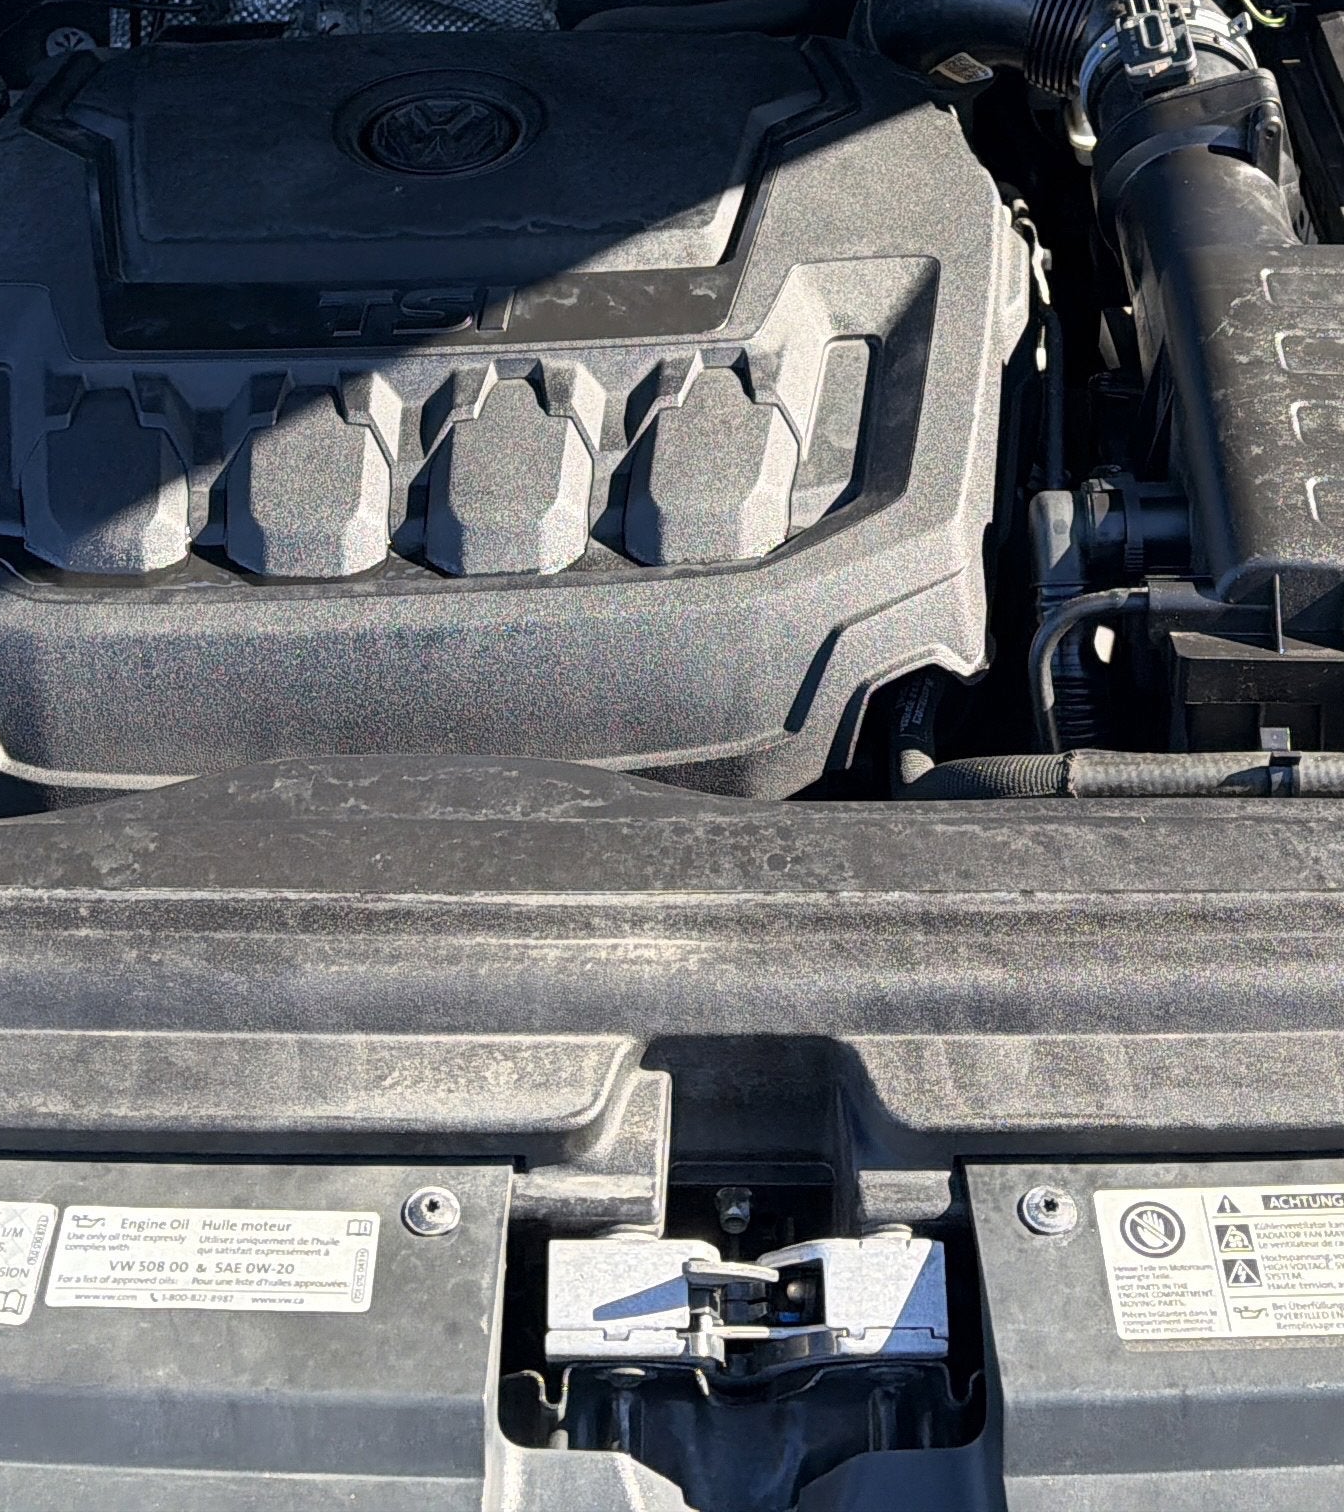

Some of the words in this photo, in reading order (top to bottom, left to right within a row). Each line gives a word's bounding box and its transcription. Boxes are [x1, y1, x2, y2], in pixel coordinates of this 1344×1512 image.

[318, 285, 516, 337] TSI
[1266, 1193, 1344, 1209] ACHTUNG
[118, 1217, 168, 1233] Engine
[168, 1218, 190, 1230] Oil
[200, 1218, 238, 1231] Huile
[240, 1220, 292, 1232] moteur
[1, 1226, 25, 1238] I/M
[65, 1231, 85, 1240] Use
[85, 1231, 107, 1243] only
[107, 1232, 121, 1241] oil
[120, 1232, 142, 1241] that
[141, 1233, 187, 1245] expressly
[1255, 1231, 1302, 1239] RADIATOR
[1302, 1230, 1323, 1238] FAN
[198, 1235, 234, 1244] Utilisez
[235, 1235, 295, 1247] uniquement
[296, 1237, 309, 1246] de
[1257, 1241, 1270, 1249] Le
[1319, 1239, 1333, 1248] de
[63, 1242, 107, 1253] complies
[107, 1243, 130, 1251] with
[196, 1246, 213, 1256] qui
[107, 1259, 135, 1272] VW
[137, 1260, 166, 1272] 508
[167, 1260, 190, 1273] 00
[195, 1263, 208, 1273] &
[213, 1261, 242, 1274] SAE
[244, 1262, 295, 1275] 0W-20
[1261, 1262, 1289, 1271] HIGH
[56, 1274, 74, 1283] For
[82, 1274, 98, 1283] list
[97, 1274, 111, 1283] of
[110, 1275, 157, 1286] approved
[191, 1276, 212, 1285] Pour
[214, 1278, 233, 1286] une
[1266, 1280, 1297, 1290] Haute
